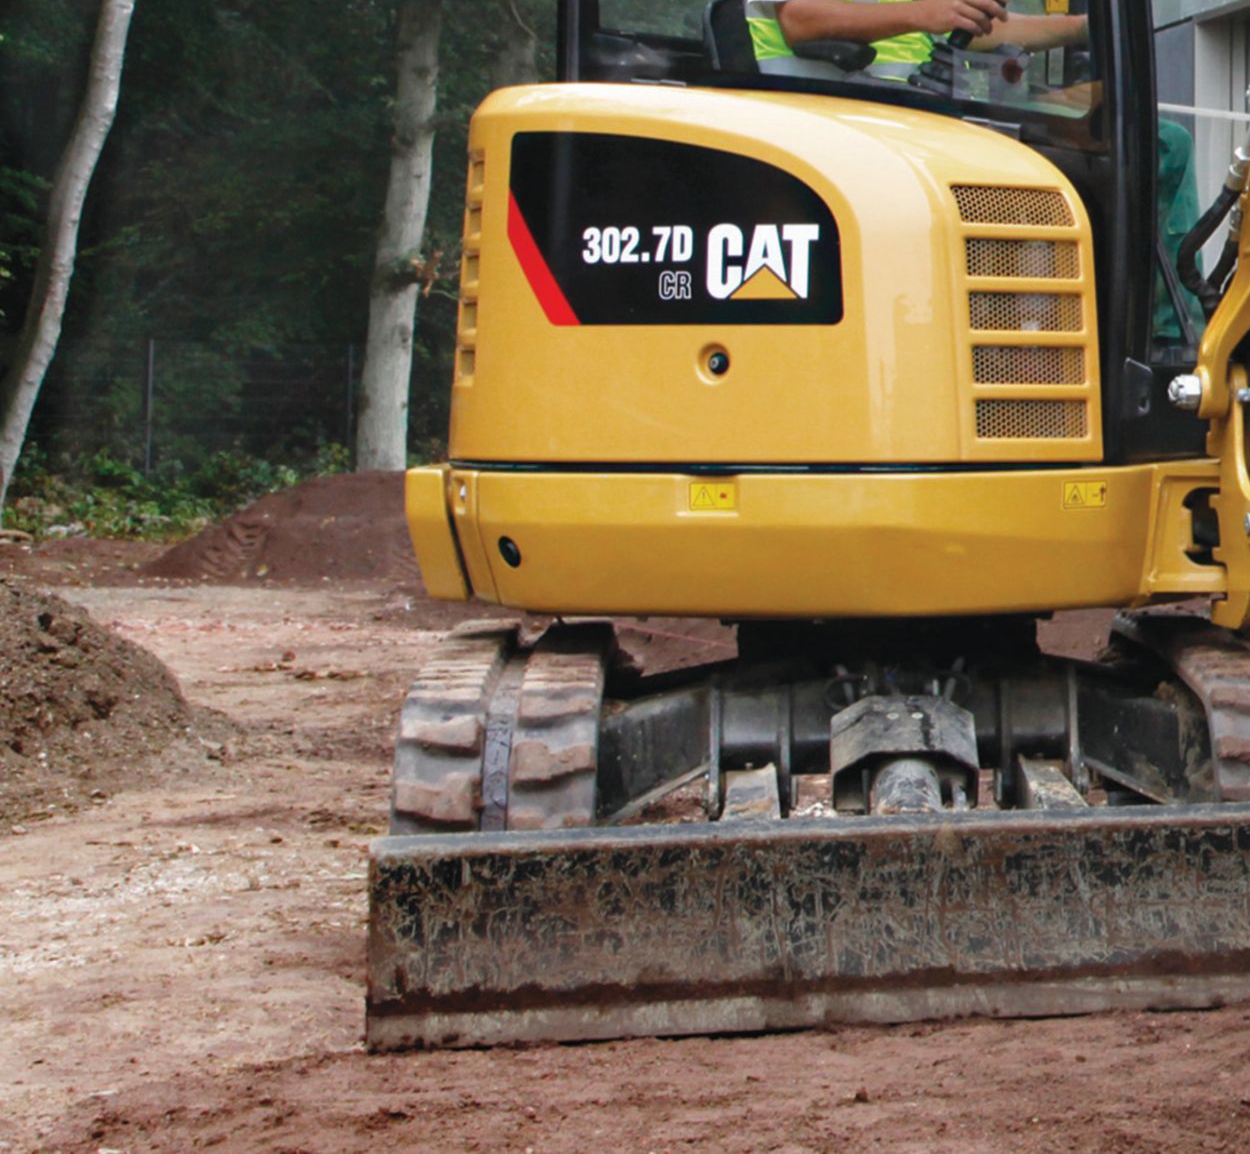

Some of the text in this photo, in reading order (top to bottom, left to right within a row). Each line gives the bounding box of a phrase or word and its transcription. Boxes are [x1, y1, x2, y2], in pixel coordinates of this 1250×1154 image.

[582, 225, 693, 264] 302.7D
[706, 223, 819, 299] CAT
[658, 271, 692, 299] CR
